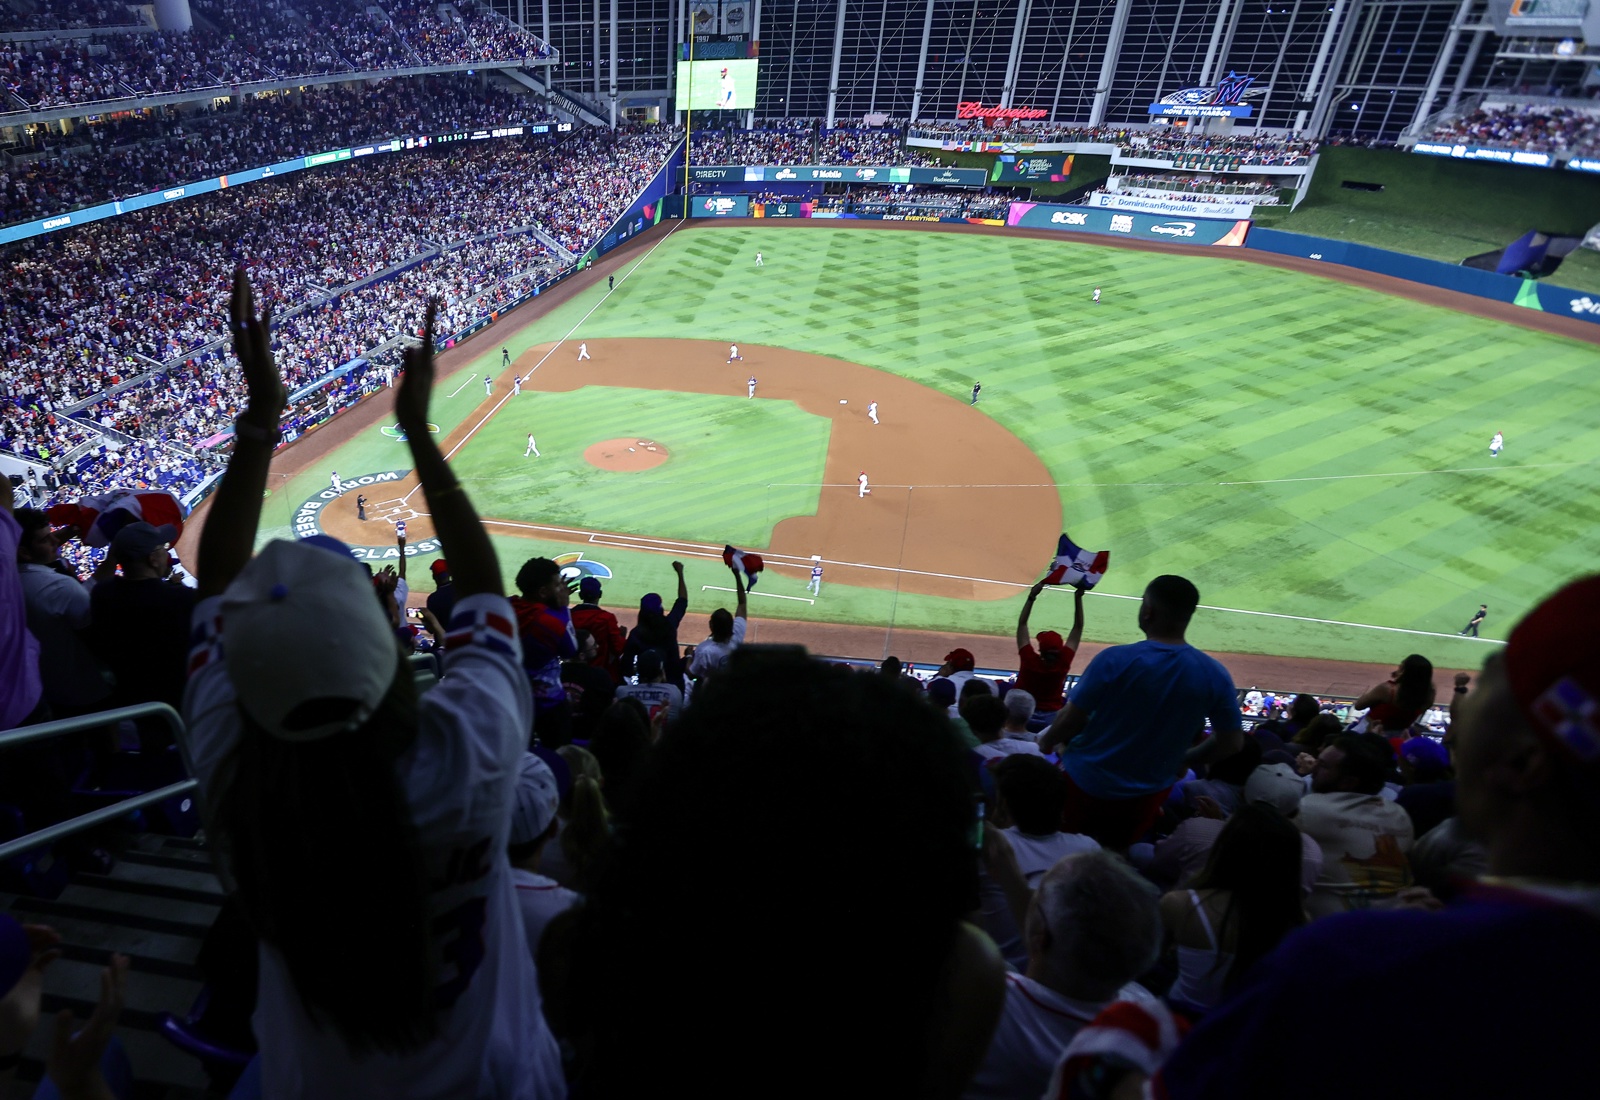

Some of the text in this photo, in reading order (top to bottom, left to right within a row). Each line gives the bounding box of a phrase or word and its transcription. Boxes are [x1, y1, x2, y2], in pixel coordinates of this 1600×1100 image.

[700, 43, 736, 57] 2026
[957, 101, 1048, 119] Budweiser
[695, 170, 727, 178] DIRECTV
[905, 215, 941, 223] EVERYTHING
[319, 471, 399, 499] WORD
[296, 501, 323, 538] BASEB
[350, 539, 442, 559] CLASS
